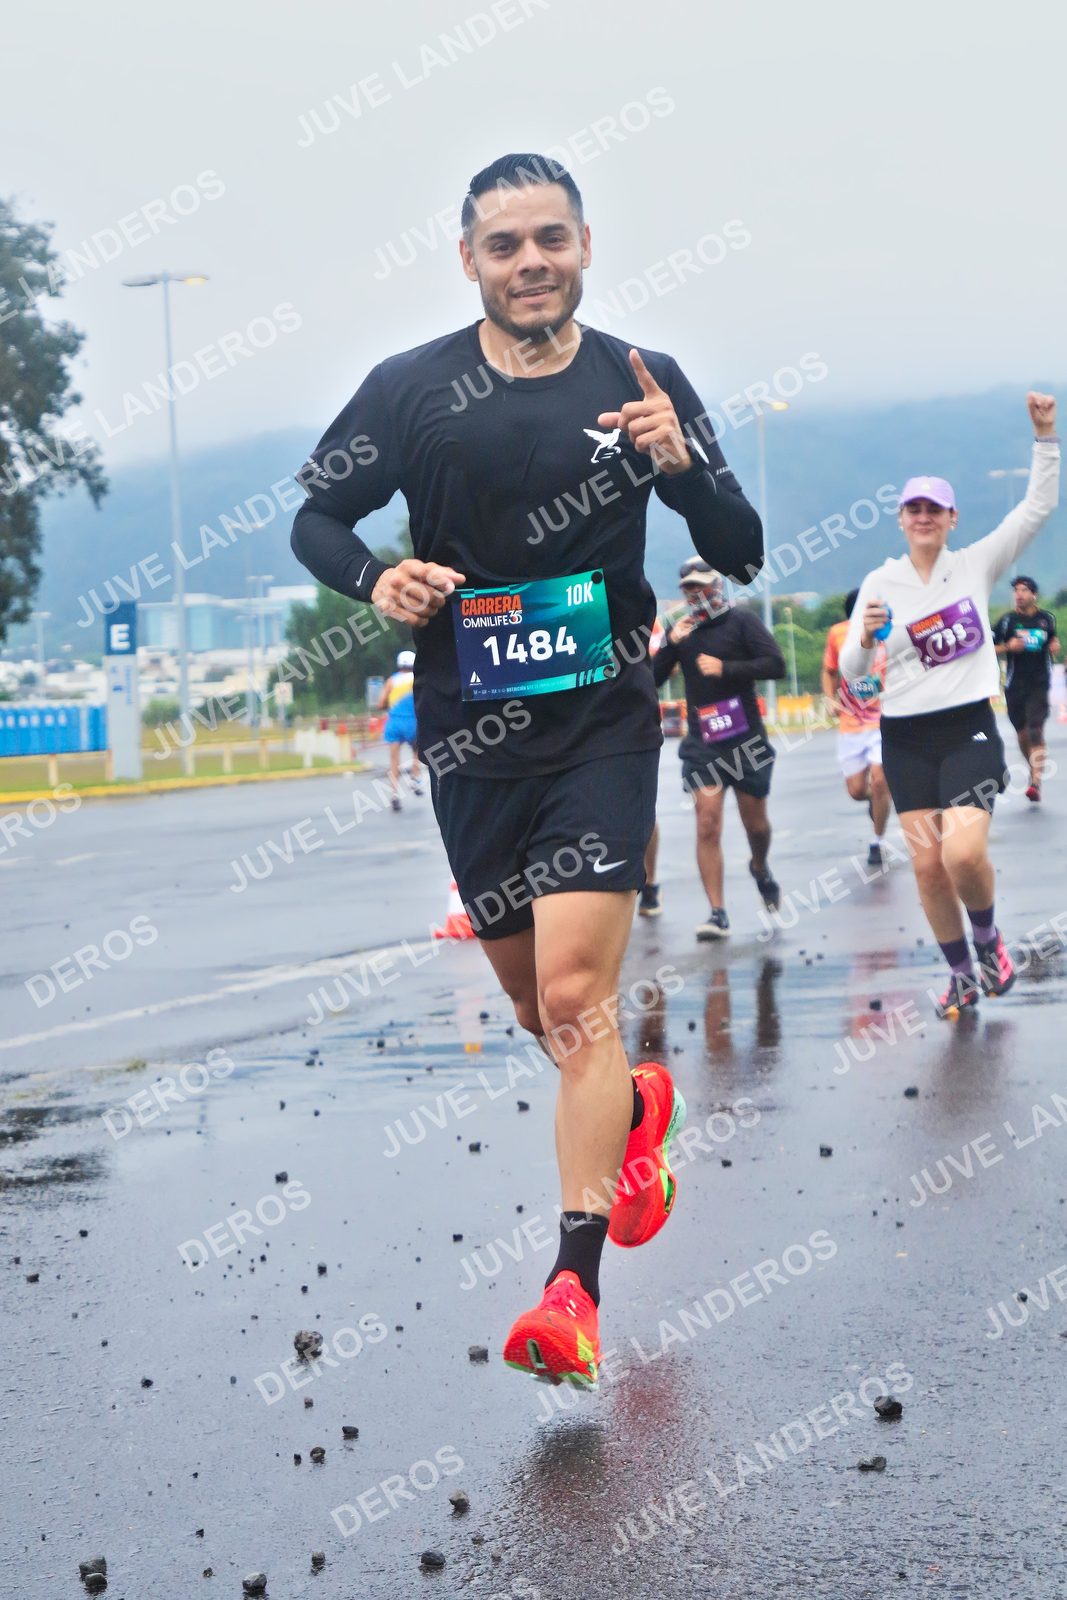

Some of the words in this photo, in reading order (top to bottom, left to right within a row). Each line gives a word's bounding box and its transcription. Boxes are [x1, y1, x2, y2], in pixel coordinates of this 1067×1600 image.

[461, 594, 522, 616] CARRERA
[566, 581, 594, 607] 10K
[110, 624, 131, 650] E
[483, 626, 577, 666] 1484
